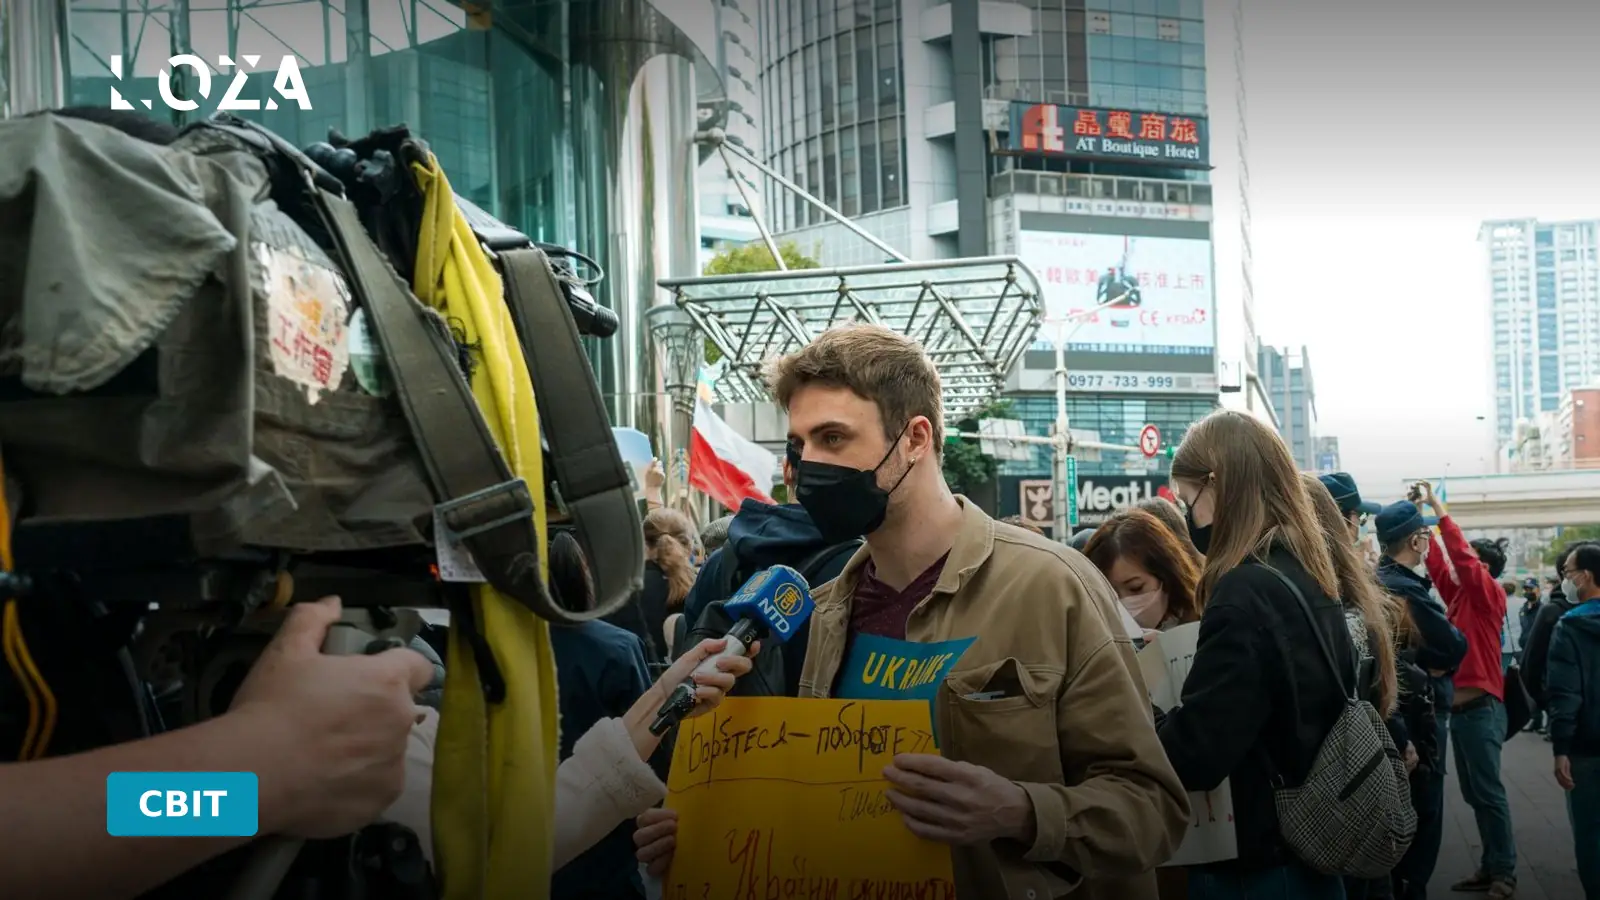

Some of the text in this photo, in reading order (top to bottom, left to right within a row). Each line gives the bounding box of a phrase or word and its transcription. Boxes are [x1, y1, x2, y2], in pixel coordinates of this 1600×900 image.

[1076, 137, 1200, 160] AT Boutique Hotel
[1077, 480, 1140, 510] Meat
[757, 596, 790, 633] NTD
[862, 651, 954, 690] UKRAINE
